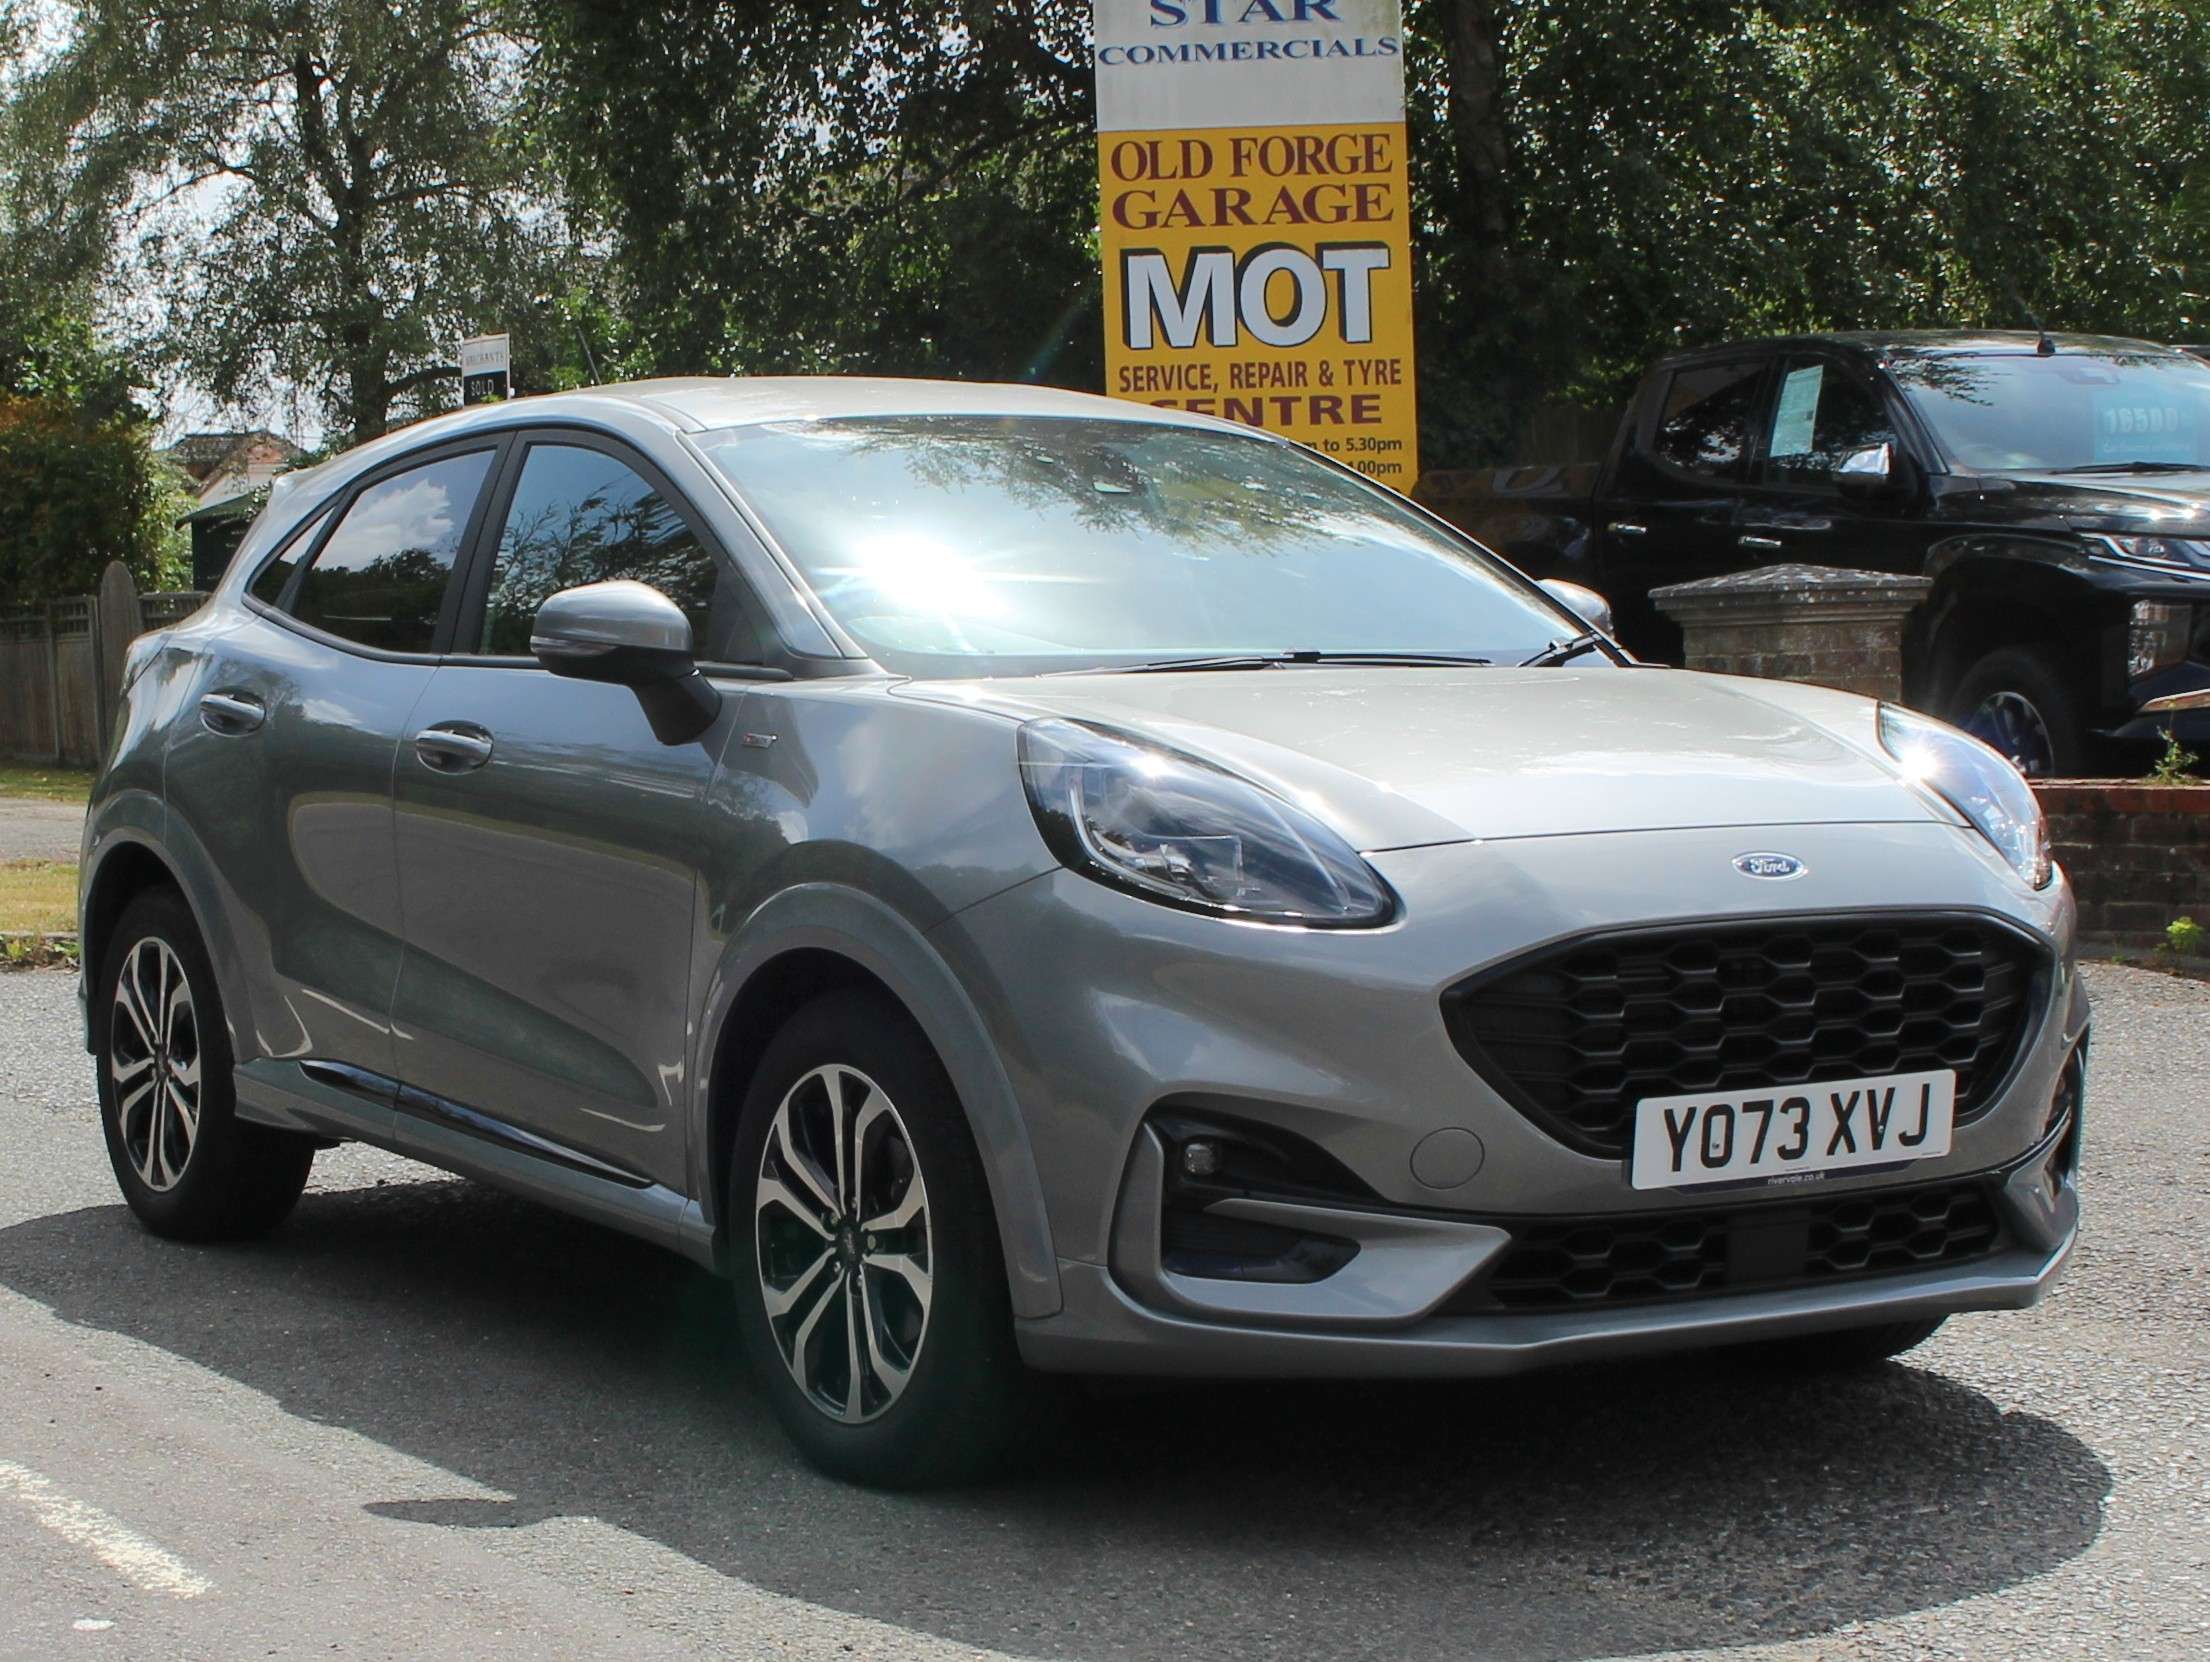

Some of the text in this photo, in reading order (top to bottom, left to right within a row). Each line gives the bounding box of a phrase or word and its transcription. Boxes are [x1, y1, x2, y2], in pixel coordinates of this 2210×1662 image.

[1098, 37, 1398, 65] COMMERCIALS
[1111, 133, 1393, 181] OLD FORGE
[1112, 183, 1394, 230] GARAGE
[1119, 241, 1391, 350] MOT
[471, 379, 494, 397] SOLD
[1119, 358, 1402, 393] SERVICE, REPAIR & TYRE
[1323, 438, 1340, 452] to
[1345, 437, 1402, 454] 5.30pm
[1749, 858, 1791, 874] Ford
[1664, 1083, 1931, 1172] YO73 XVJ
